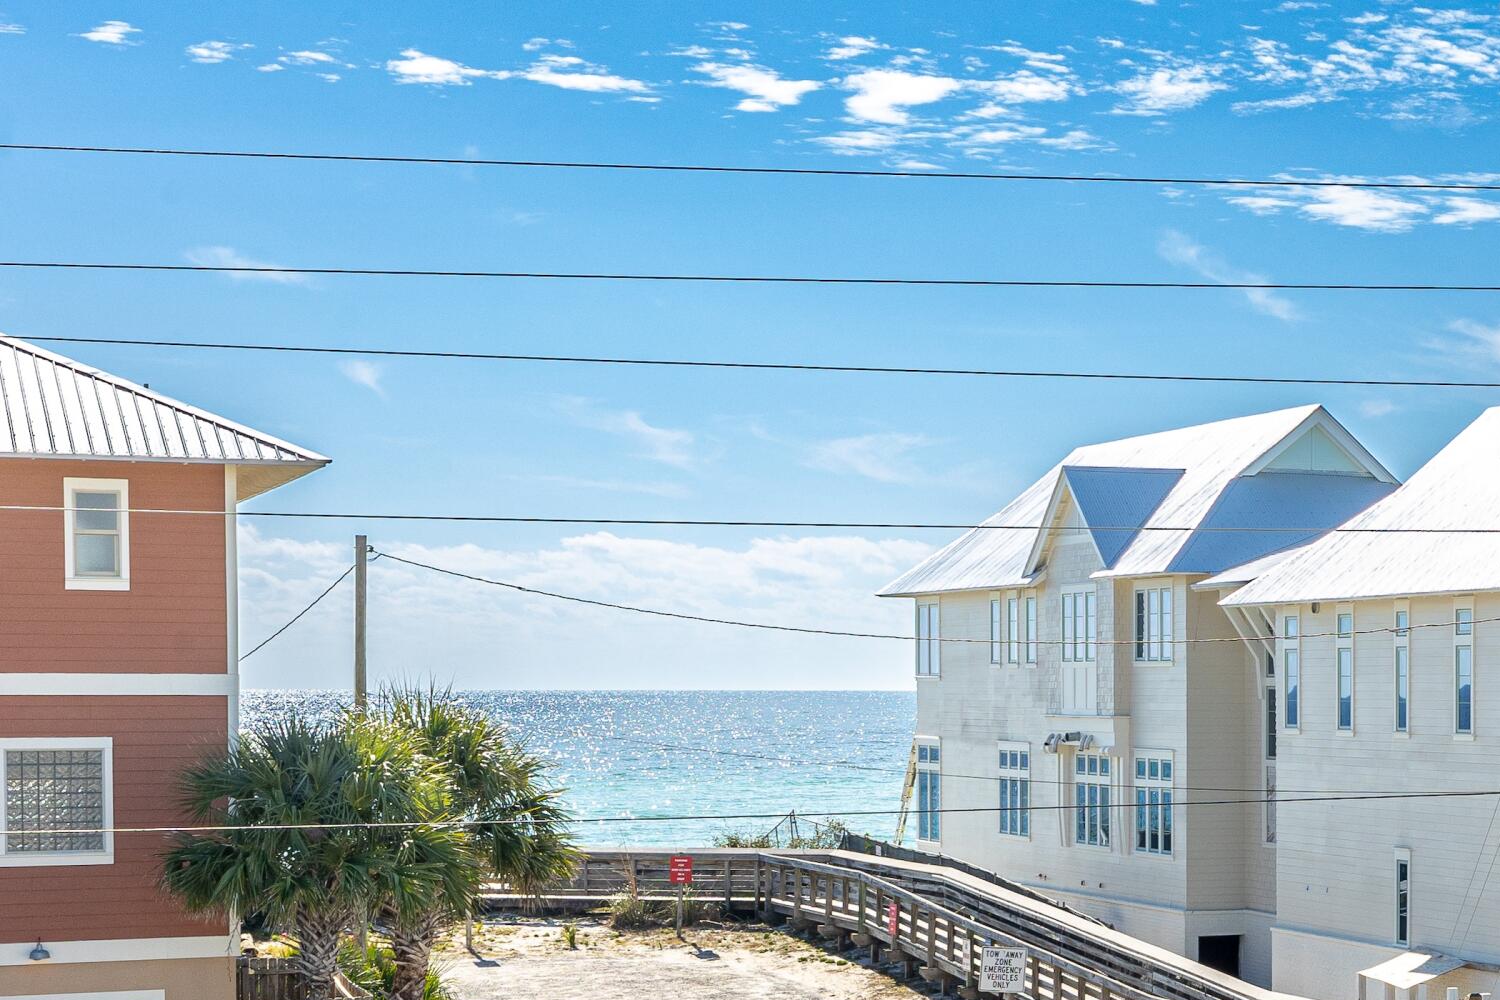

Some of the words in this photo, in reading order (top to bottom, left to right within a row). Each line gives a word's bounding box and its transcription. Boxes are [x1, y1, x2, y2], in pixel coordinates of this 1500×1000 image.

[986, 950, 1000, 958] TOW
[1006, 951, 1023, 959] AWAY
[995, 958, 1013, 966] ZONE
[984, 966, 1022, 974] EMERGENCY
[987, 973, 1019, 982] VEHICLES
[992, 981, 1010, 989] ONLY
